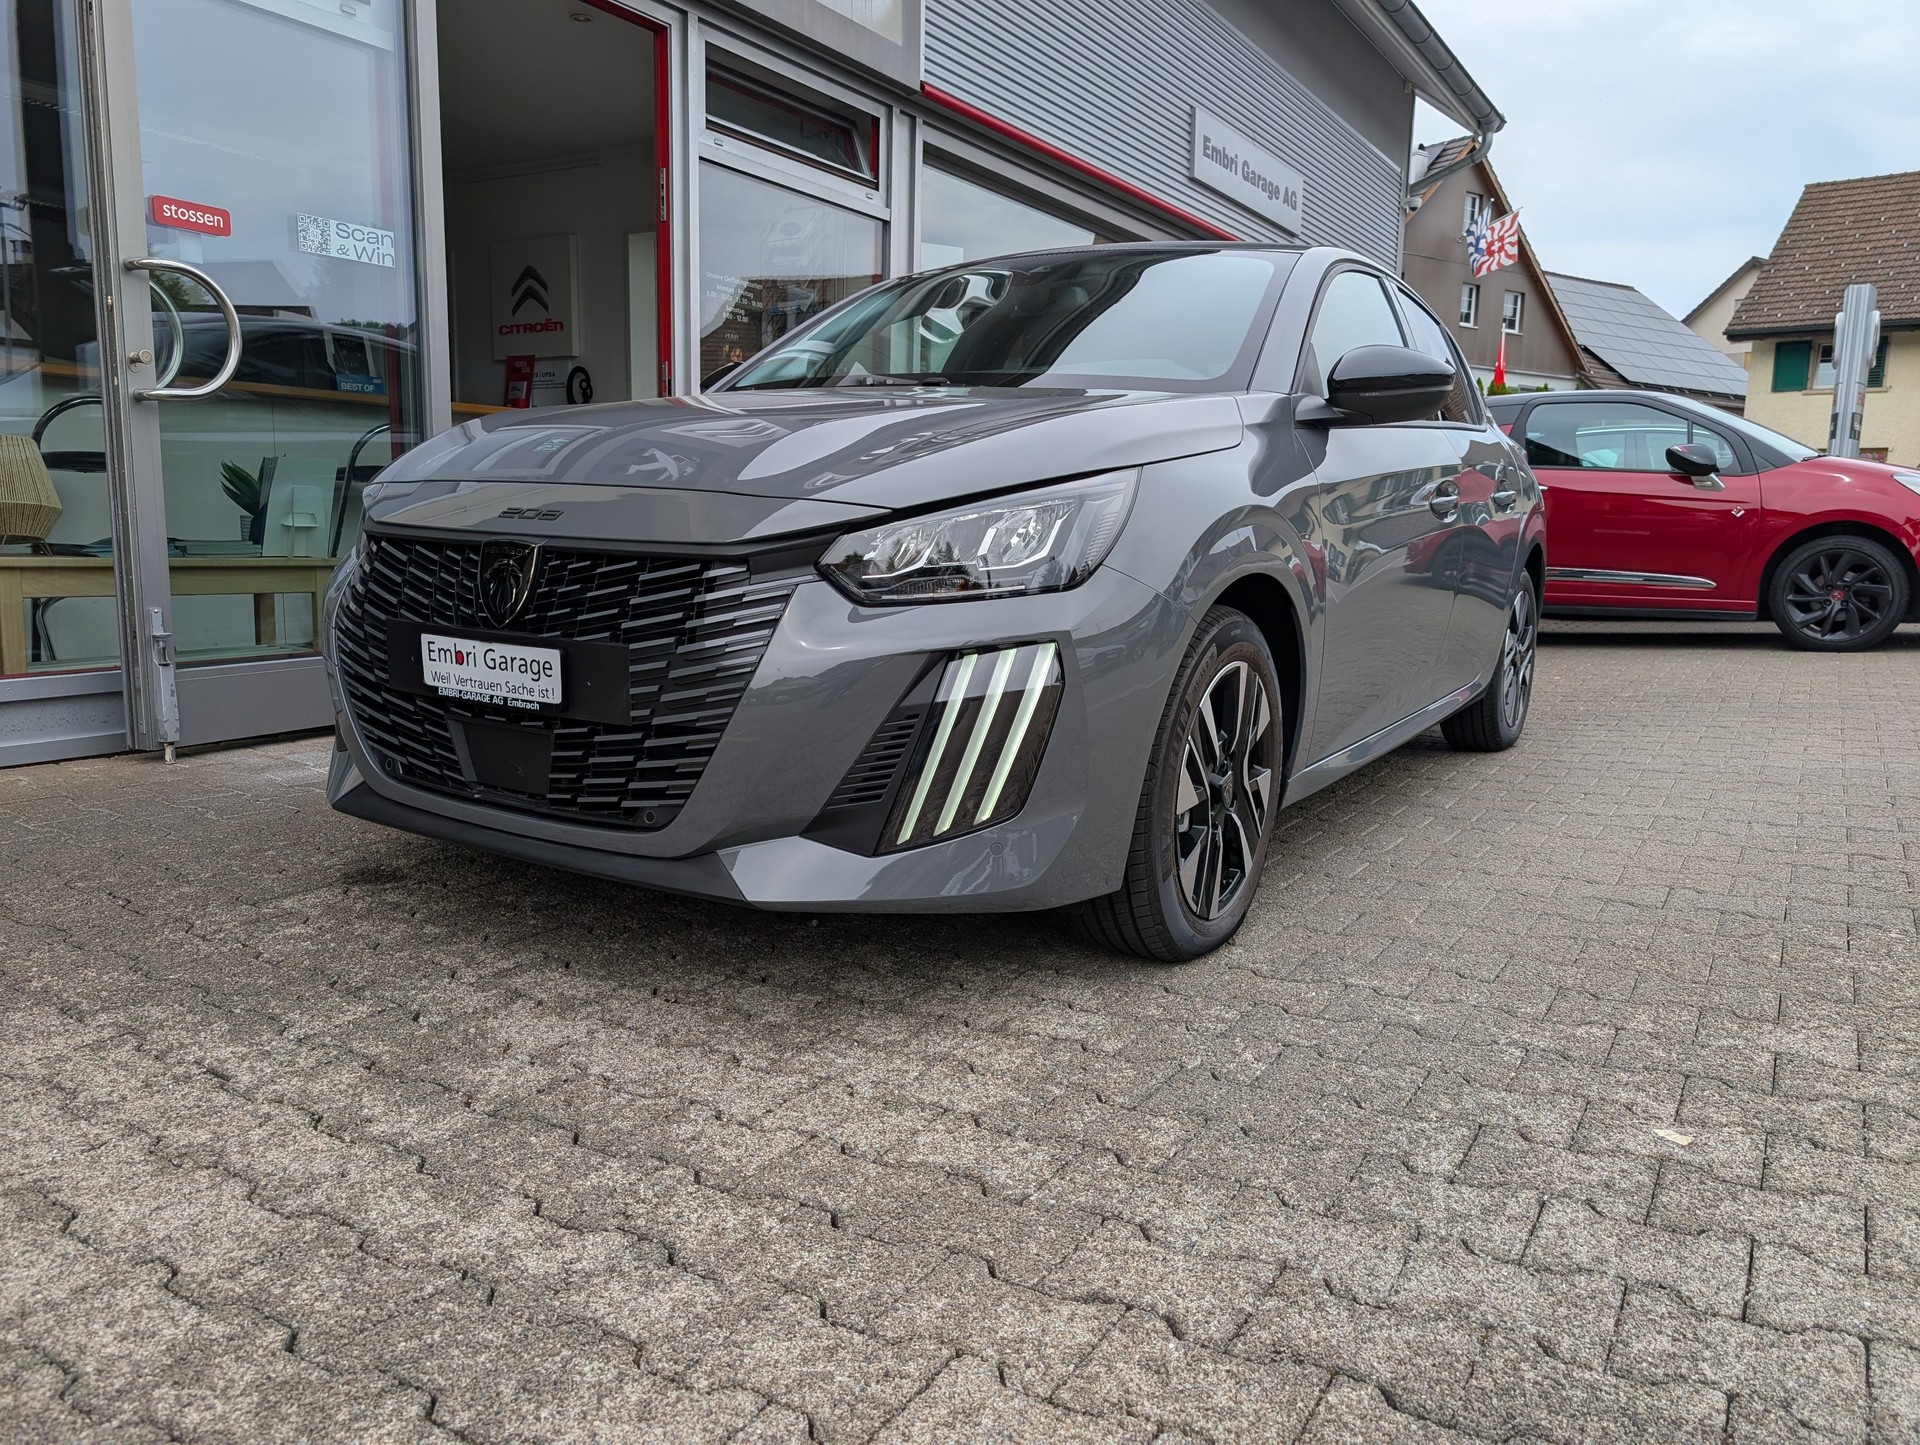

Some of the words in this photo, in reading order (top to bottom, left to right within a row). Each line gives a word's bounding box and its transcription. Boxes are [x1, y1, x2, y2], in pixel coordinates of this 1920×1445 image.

[1202, 134, 1238, 176] Embri
[1241, 159, 1281, 201] Garage
[1282, 185, 1298, 212] AG
[162, 204, 224, 228] stossen
[335, 221, 394, 249] Scan
[336, 243, 350, 257] &
[352, 243, 396, 267] Win
[706, 271, 723, 279] Unsere
[716, 284, 734, 294] Montag
[737, 288, 754, 299] Freitag
[340, 382, 363, 391] BEST
[363, 384, 375, 392] OF
[498, 507, 565, 521] 208
[427, 640, 477, 668] Embri
[483, 648, 553, 682] Garage
[430, 670, 451, 685] Weil
[453, 673, 503, 693] Vertrauen
[505, 681, 535, 697] Sache
[438, 686, 491, 704] EMBRI-GARAGE
[492, 695, 504, 705] AG
[507, 697, 540, 711] Embrach
